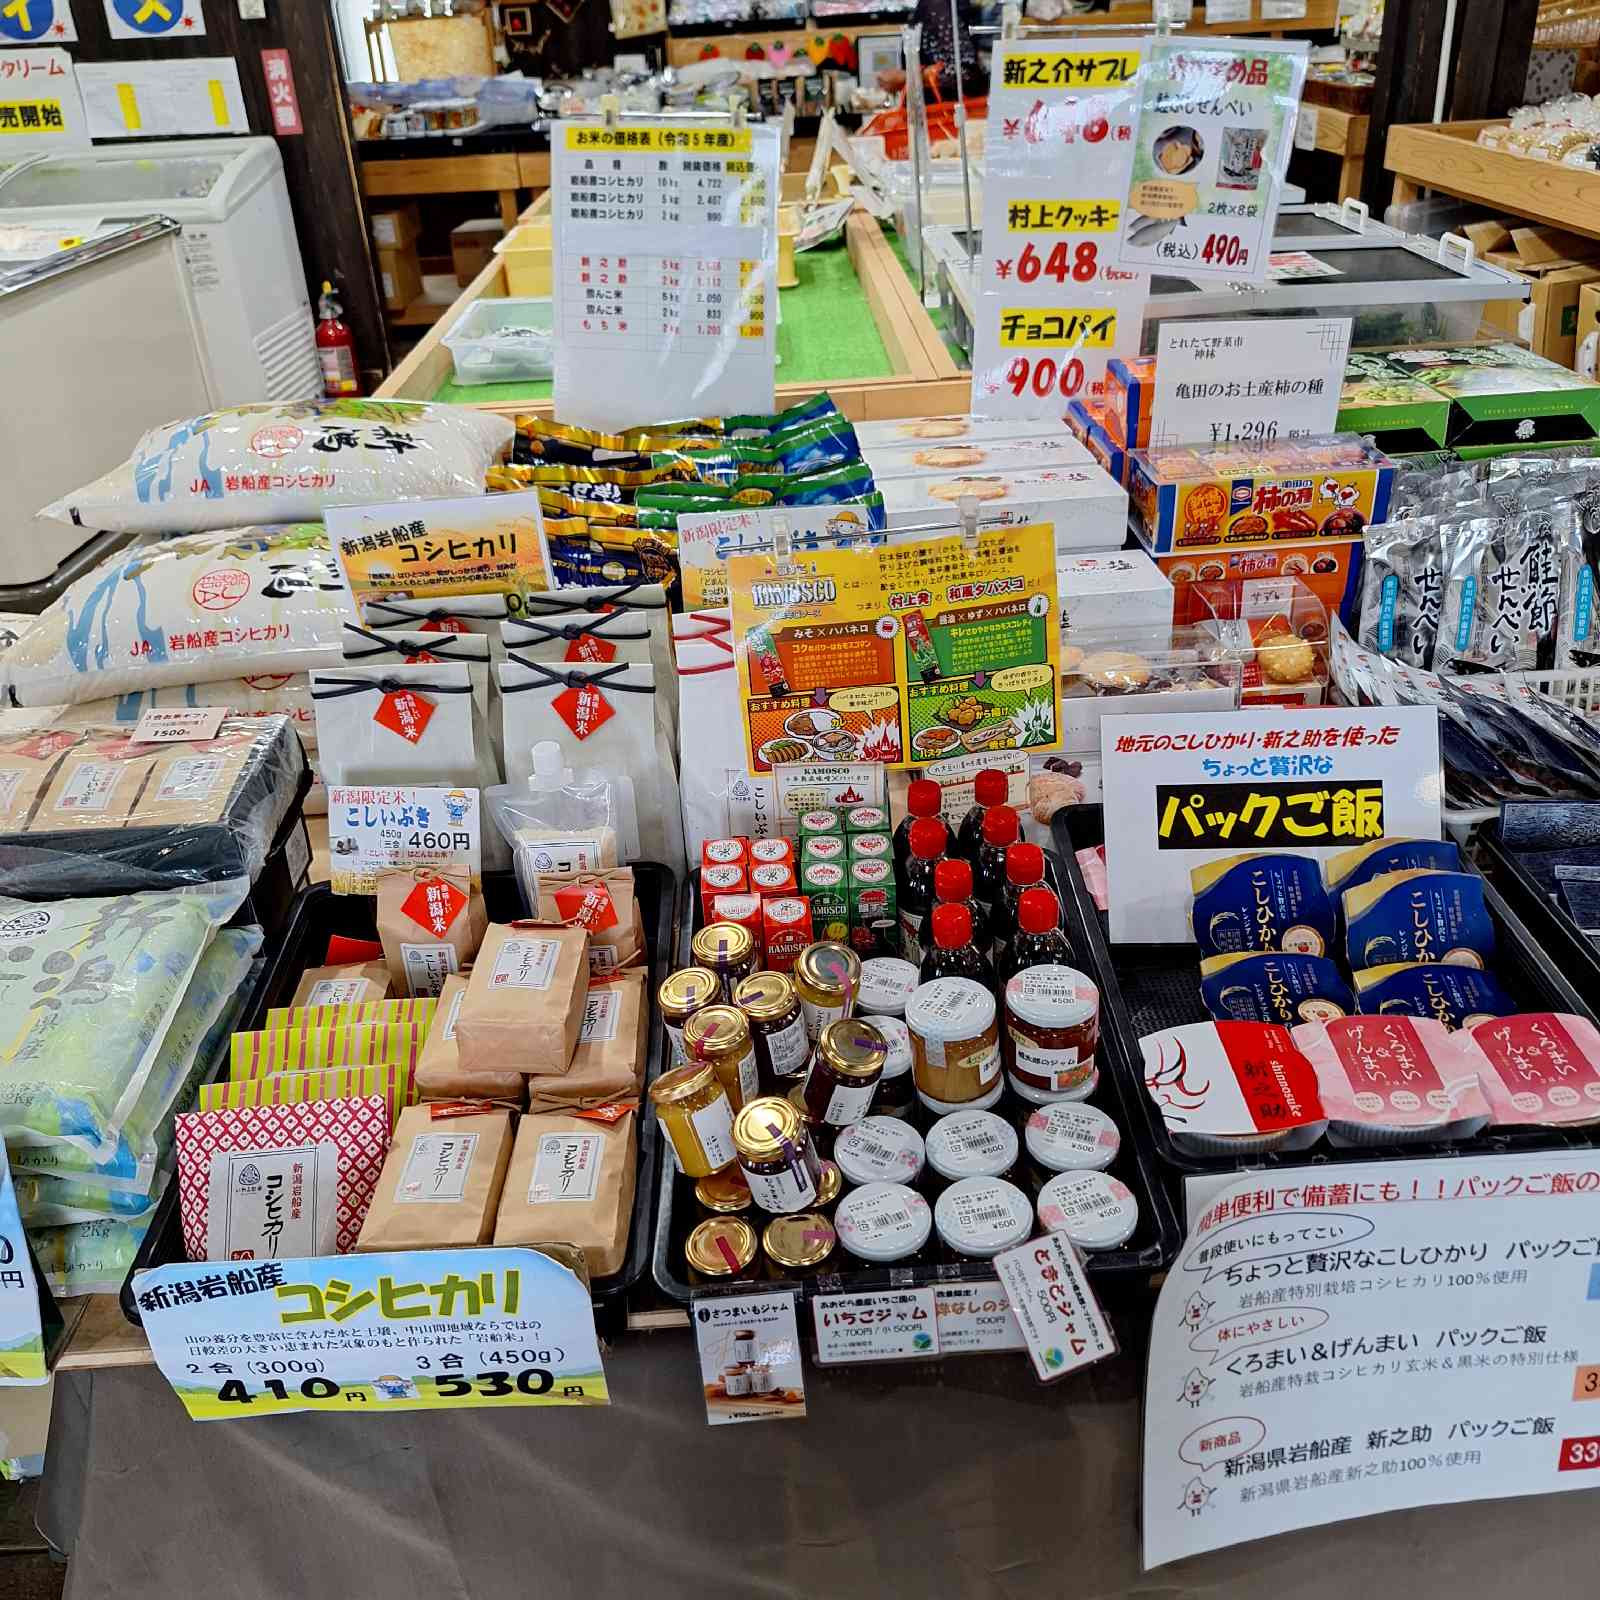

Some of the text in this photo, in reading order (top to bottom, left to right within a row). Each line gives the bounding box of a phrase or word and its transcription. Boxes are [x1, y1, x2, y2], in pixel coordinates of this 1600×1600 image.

[1000, 314, 1116, 342] チョコパイ
[1169, 336, 1244, 349] とれたて野菜市
[1175, 378, 1323, 400] 亀田のお土産柿の種
[225, 474, 337, 491] 岩船産コシヒカリ
[340, 520, 429, 558] 新潟岩船産
[400, 533, 517, 563] コシヒカリ
[889, 591, 932, 610] 村上発
[947, 577, 1024, 604] 和風タバスコ
[1490, 566, 1522, 654] せんべい
[168, 623, 290, 652] 岩船産コシヒカリ
[750, 696, 811, 712] おすすめ料理
[909, 680, 969, 698] おすすめ料理
[393, 697, 419, 740] 新潟米
[576, 691, 592, 735] 新潟米
[803, 767, 851, 775] KAMOSCO
[1201, 754, 1334, 778] ちょっと贅沢な
[346, 805, 431, 829] こしいぶき
[754, 786, 768, 838] こしいぶ
[1157, 787, 1385, 839] パックご飯
[408, 831, 471, 851] 460円
[425, 885, 447, 933] 新潟米
[1269, 1059, 1303, 1118] shinnosuke
[260, 1174, 284, 1260] コシヒカリ
[1224, 1243, 1488, 1287] ちょっと贅沢なこしひかり
[139, 1262, 288, 1312] 新潟岩船産
[275, 1269, 520, 1324] コシヒカリ
[711, 1302, 790, 1320] さつまいもジャム
[823, 1306, 928, 1328] いちごジャム
[1217, 1313, 1305, 1343] 体にやさしい
[1436, 1325, 1548, 1349] パックご飯
[1199, 1431, 1242, 1453] 新商品
[1224, 1416, 1557, 1480] 新潟県岩船産 新之助 パックご飯
